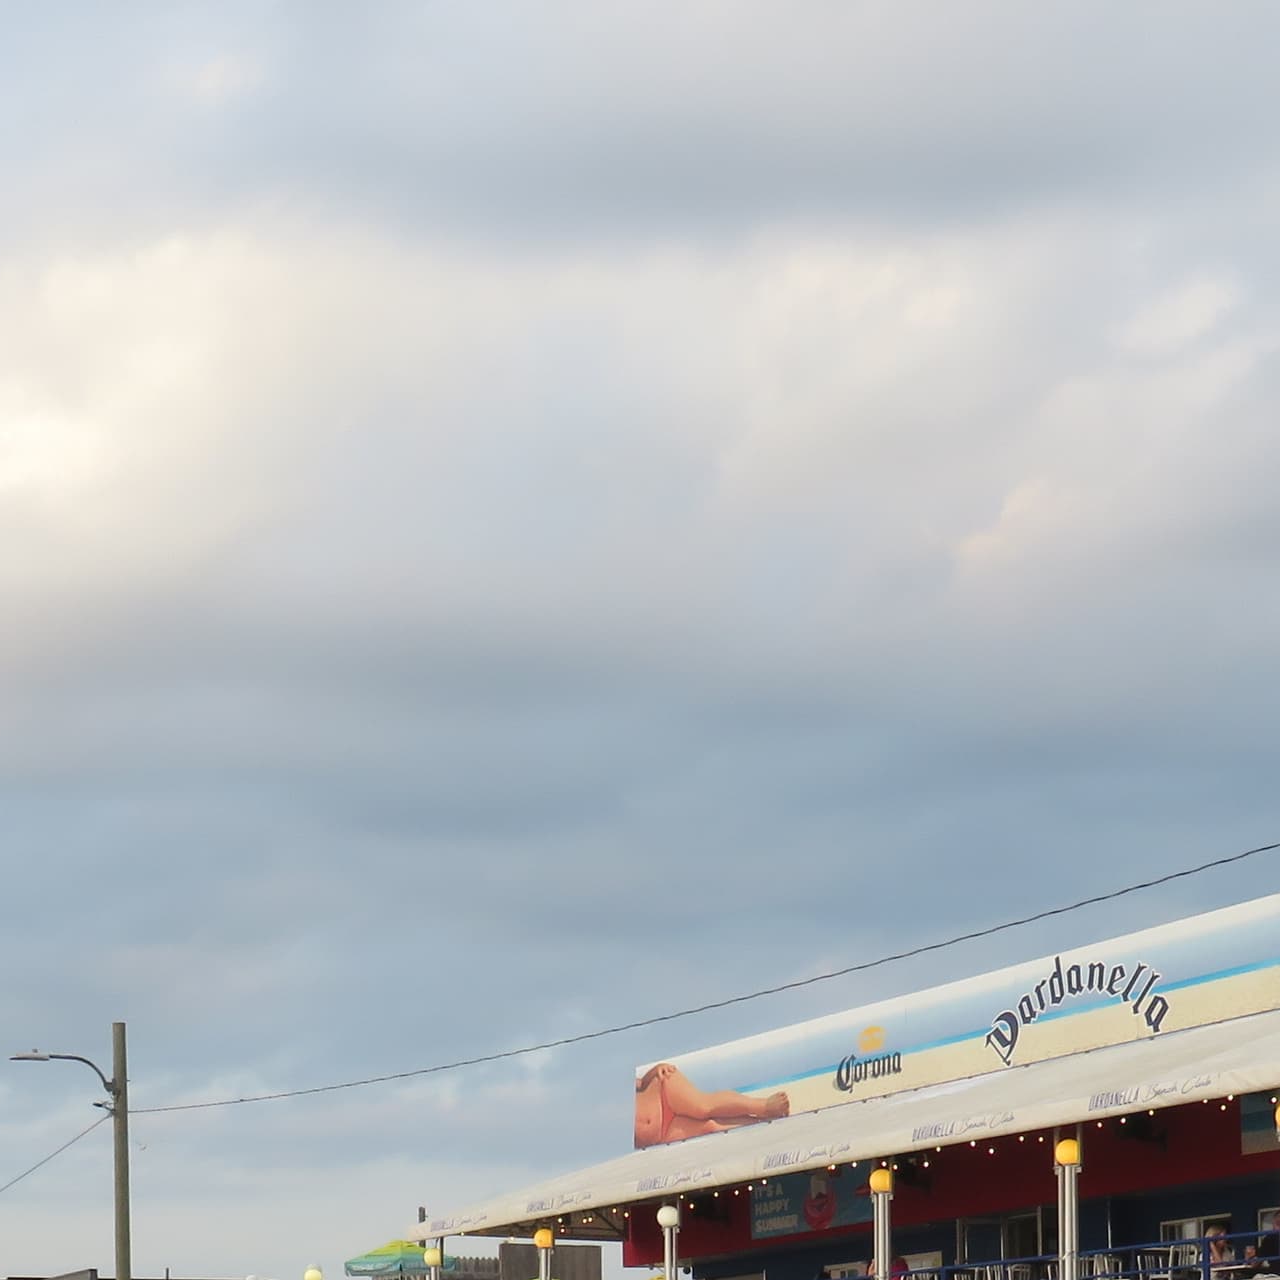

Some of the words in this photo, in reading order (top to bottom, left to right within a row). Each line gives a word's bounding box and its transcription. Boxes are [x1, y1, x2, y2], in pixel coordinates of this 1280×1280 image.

[984, 955, 1170, 1067] Dardanella
[836, 1051, 902, 1094] Corona
[754, 1198, 790, 1216] HAPPY
